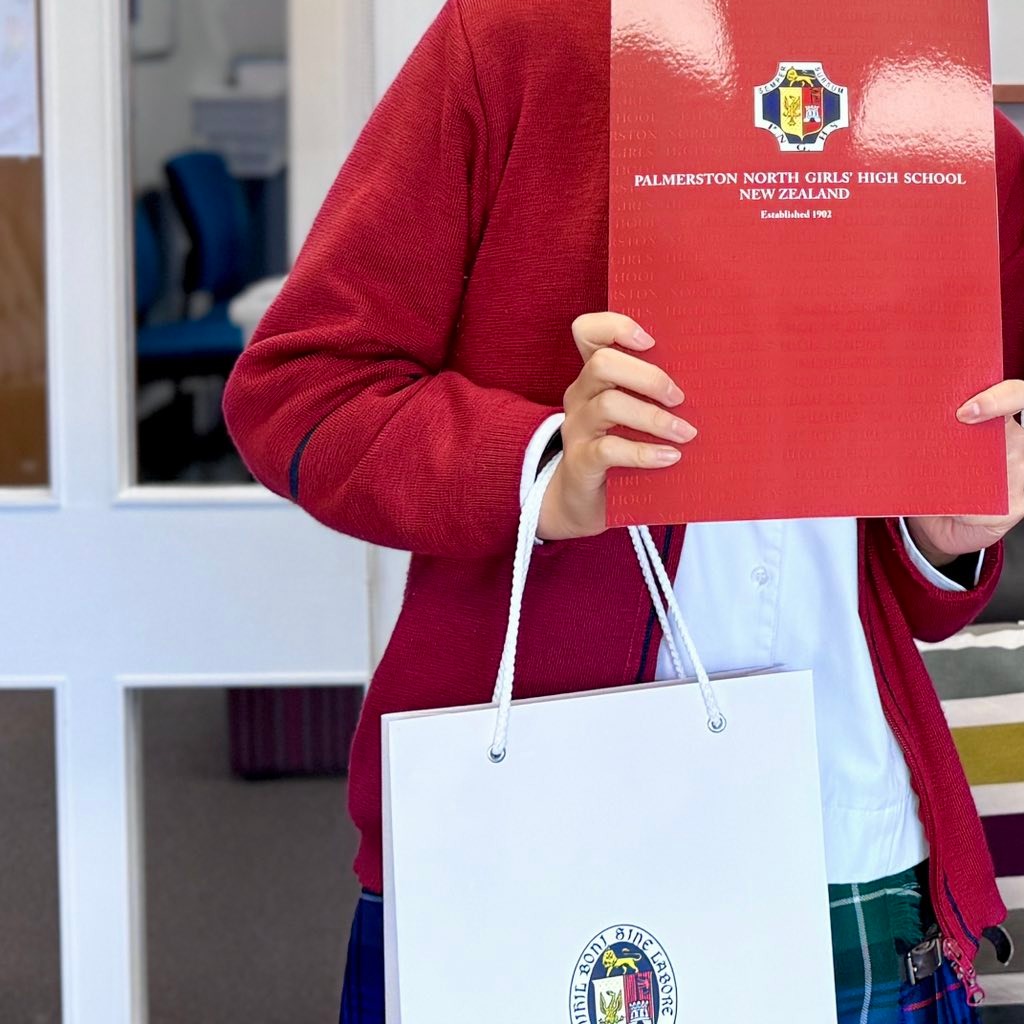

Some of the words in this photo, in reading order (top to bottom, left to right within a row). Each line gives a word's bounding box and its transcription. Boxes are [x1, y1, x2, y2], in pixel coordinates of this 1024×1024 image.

[634, 173, 738, 187] PALMERSTON
[743, 172, 799, 184] NORTH
[804, 171, 853, 184] GIRLS'
[858, 172, 898, 184] HIGH
[903, 172, 967, 185] SCHOOL
[739, 188, 775, 201] NEW
[778, 187, 850, 201] ZEALAND
[760, 210, 810, 219] Established
[812, 210, 832, 219] 1902
[615, 927, 653, 951] SINE
[650, 951, 674, 1017] LABORE
